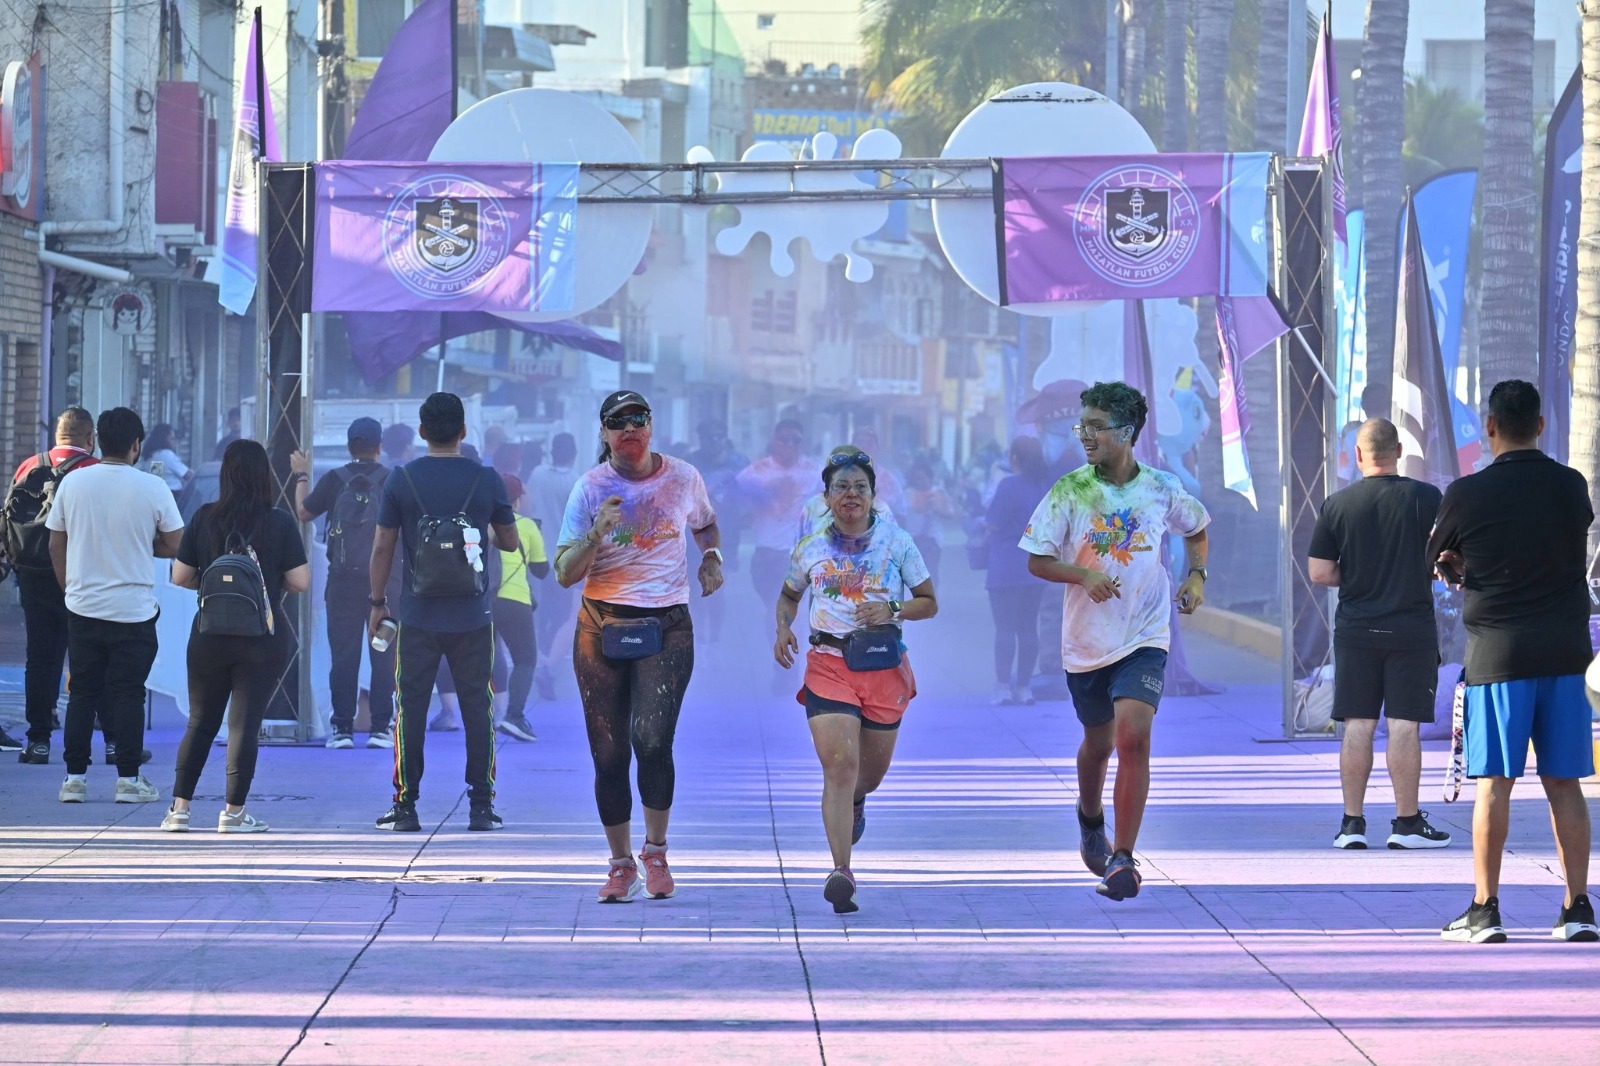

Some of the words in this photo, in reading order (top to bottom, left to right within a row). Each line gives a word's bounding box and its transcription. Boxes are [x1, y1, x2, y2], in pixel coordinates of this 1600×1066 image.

[1134, 260, 1172, 278] FUTBOL
[1172, 235, 1189, 259] CLUB
[441, 274, 480, 291] FUTBOL
[480, 250, 499, 274] CLUB
[1131, 531, 1148, 544] 5K
[864, 573, 881, 587] 5K
